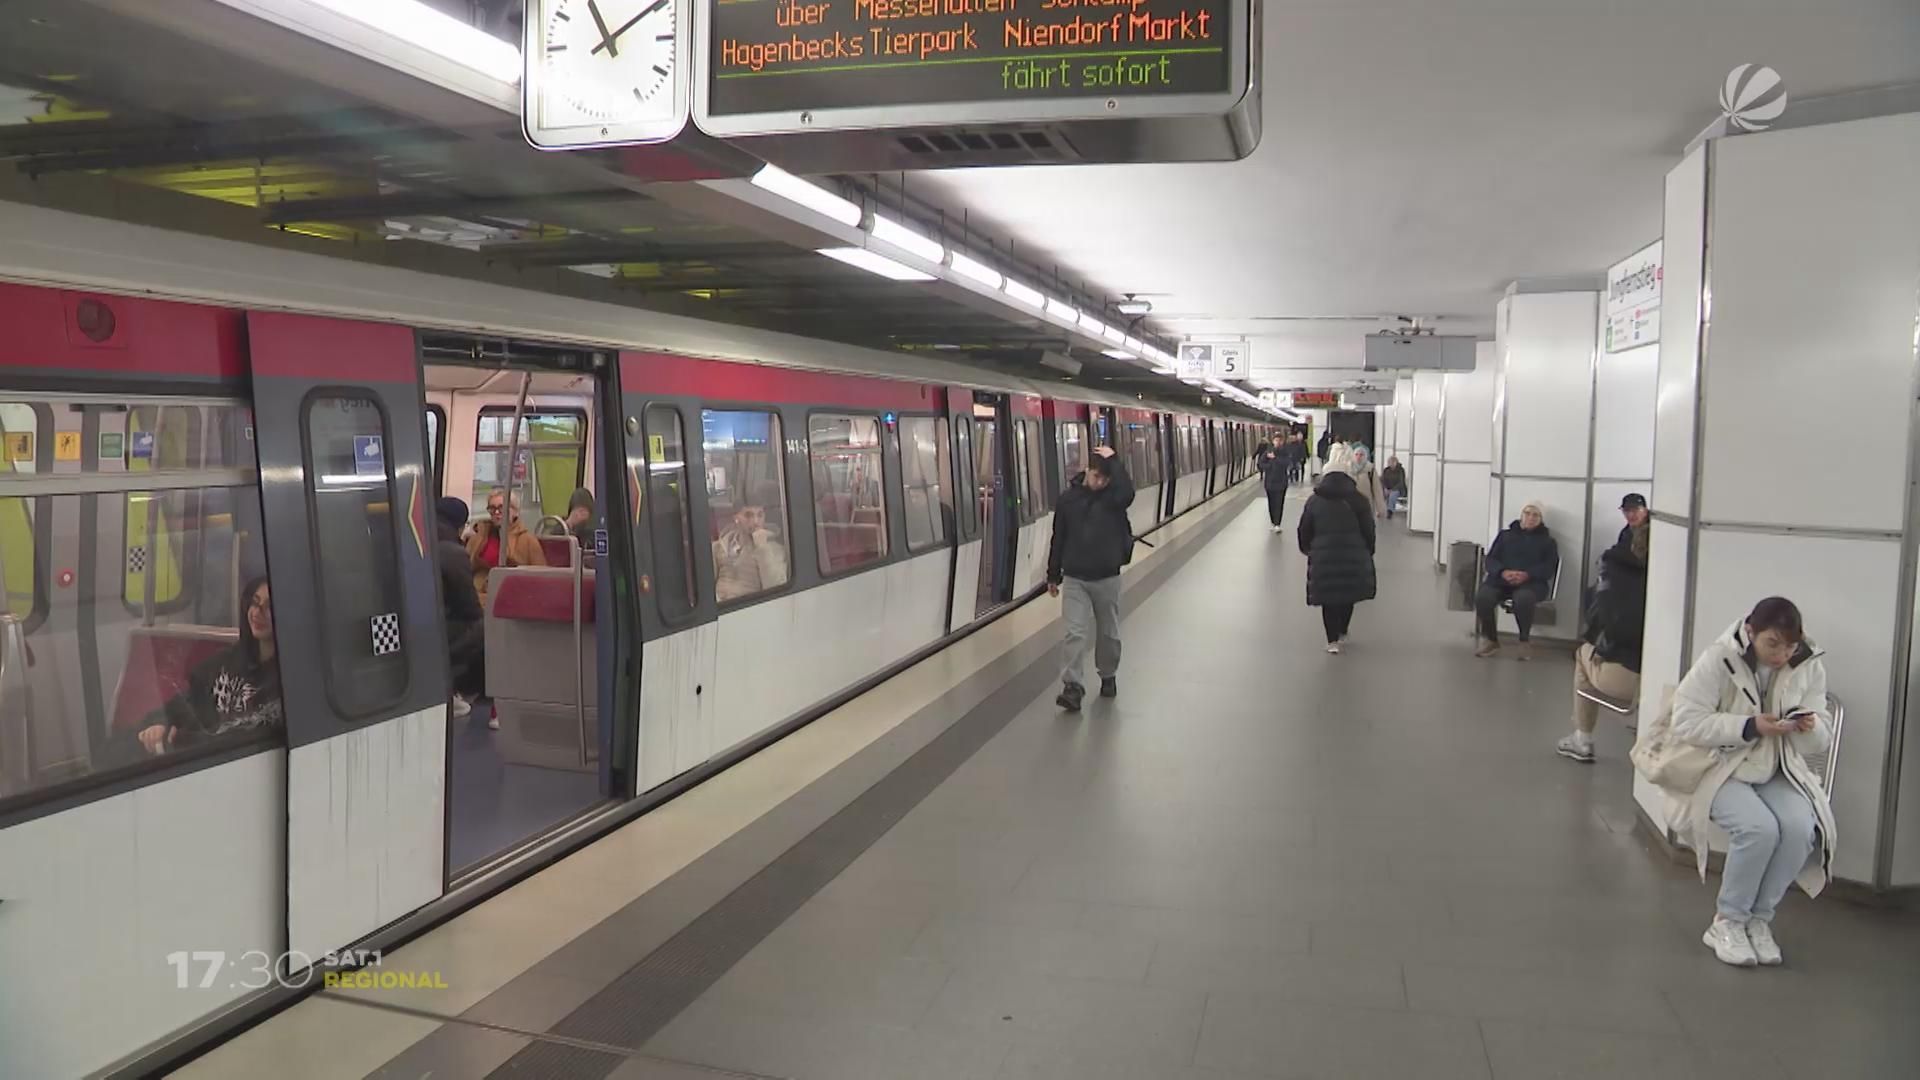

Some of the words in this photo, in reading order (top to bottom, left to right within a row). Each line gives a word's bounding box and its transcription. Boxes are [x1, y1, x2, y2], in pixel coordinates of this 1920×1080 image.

[776, 0, 831, 27] über
[1004, 13, 1123, 48] Niendorf
[1129, 9, 1211, 42] Markt
[721, 31, 864, 72] Hagenbecks
[869, 23, 977, 60] Tierpark
[1001, 60, 1070, 89] fährt
[1082, 55, 1171, 87] sofort
[1225, 357, 1235, 372] 5
